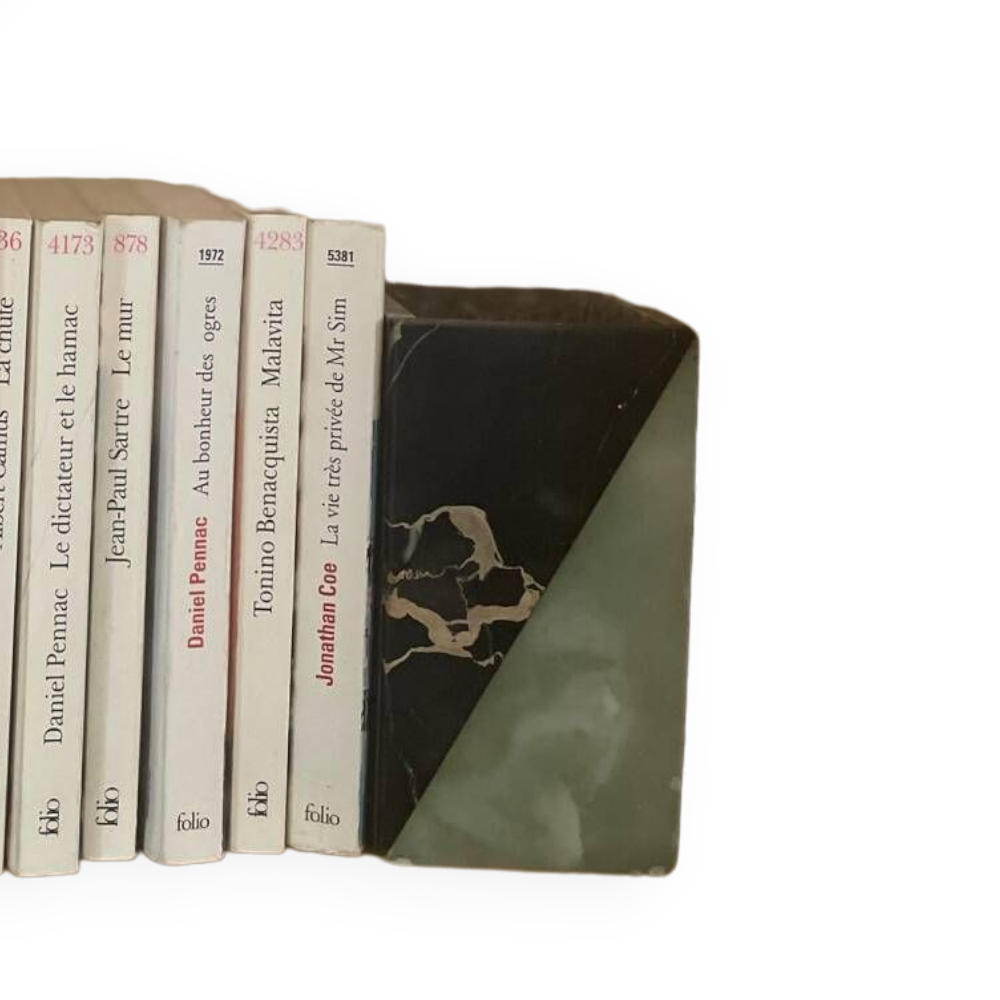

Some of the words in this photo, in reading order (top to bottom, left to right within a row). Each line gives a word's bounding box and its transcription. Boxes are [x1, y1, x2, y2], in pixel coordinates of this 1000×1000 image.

[47, 234, 95, 255] 4173
[113, 233, 149, 254] 878
[199, 248, 225, 262] 1972
[253, 230, 305, 251] 4283
[327, 249, 354, 263] 5381
[118, 296, 134, 341] mur
[203, 295, 222, 342] ogres
[327, 297, 348, 333] Sim
[56, 303, 79, 377] hamac
[261, 299, 284, 387] Malavita
[326, 337, 346, 367] Mr
[111, 349, 132, 377] Le
[195, 353, 214, 382] des
[55, 384, 76, 403] le
[324, 371, 345, 393] de
[60, 408, 75, 431] et
[107, 398, 131, 461] Sartre
[192, 387, 213, 463] bonheur
[323, 398, 348, 452] privée
[51, 435, 74, 536] dictateur
[192, 469, 210, 496] Au
[256, 405, 286, 534] Benacquista
[323, 456, 342, 487] très
[105, 469, 132, 569] Jean-Paul
[321, 493, 341, 518] vie
[189, 515, 208, 585] Pennac
[320, 524, 339, 546] La
[50, 541, 71, 571] Le
[253, 540, 276, 618] Tonino
[318, 562, 338, 597] Coe
[46, 587, 69, 668] Pennac
[187, 590, 206, 650] Daniel
[315, 601, 338, 687] Jonathan
[43, 674, 66, 746] Daniel
[38, 797, 60, 837] folio
[96, 785, 120, 827] folio
[248, 780, 269, 818] folio
[303, 803, 341, 827] folio
[176, 812, 210, 832] folio
